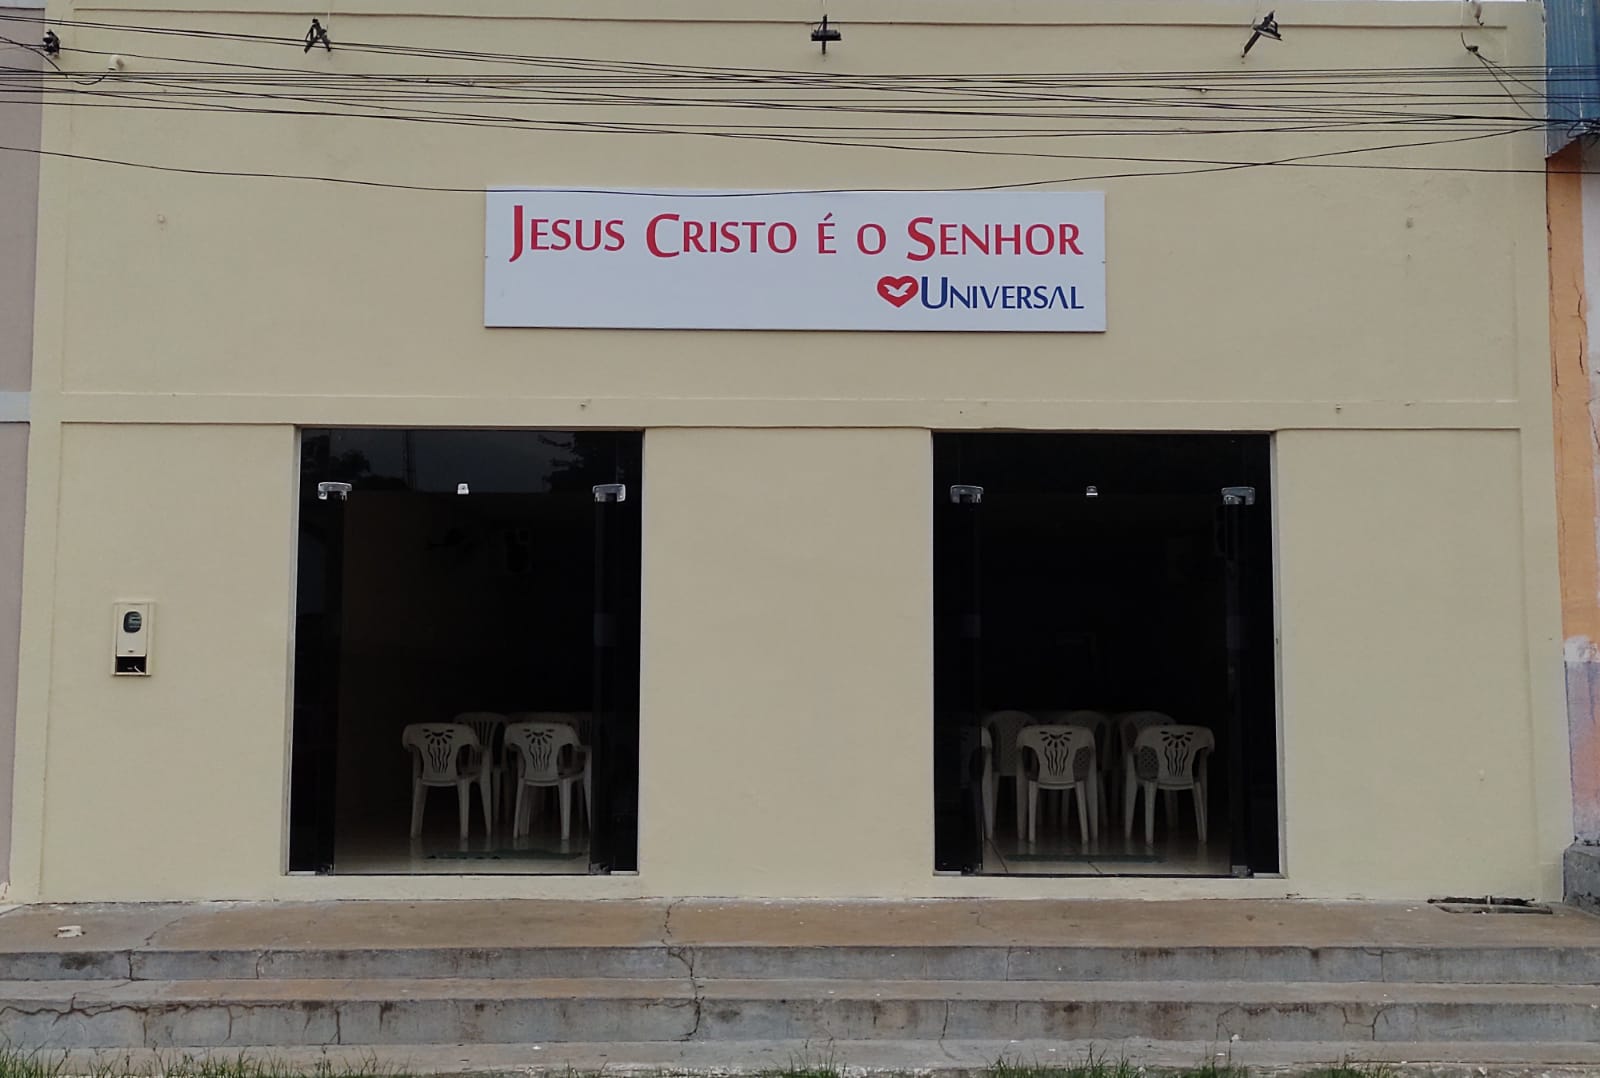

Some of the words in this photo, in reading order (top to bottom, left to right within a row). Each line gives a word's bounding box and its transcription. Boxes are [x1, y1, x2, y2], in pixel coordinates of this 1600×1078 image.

[509, 204, 625, 263] JESUS
[646, 213, 798, 259] CRISTO
[817, 212, 837, 255] É
[857, 223, 887, 256] O
[906, 217, 1083, 262] SENHOR
[920, 275, 1083, 310] UNIVERSAL
